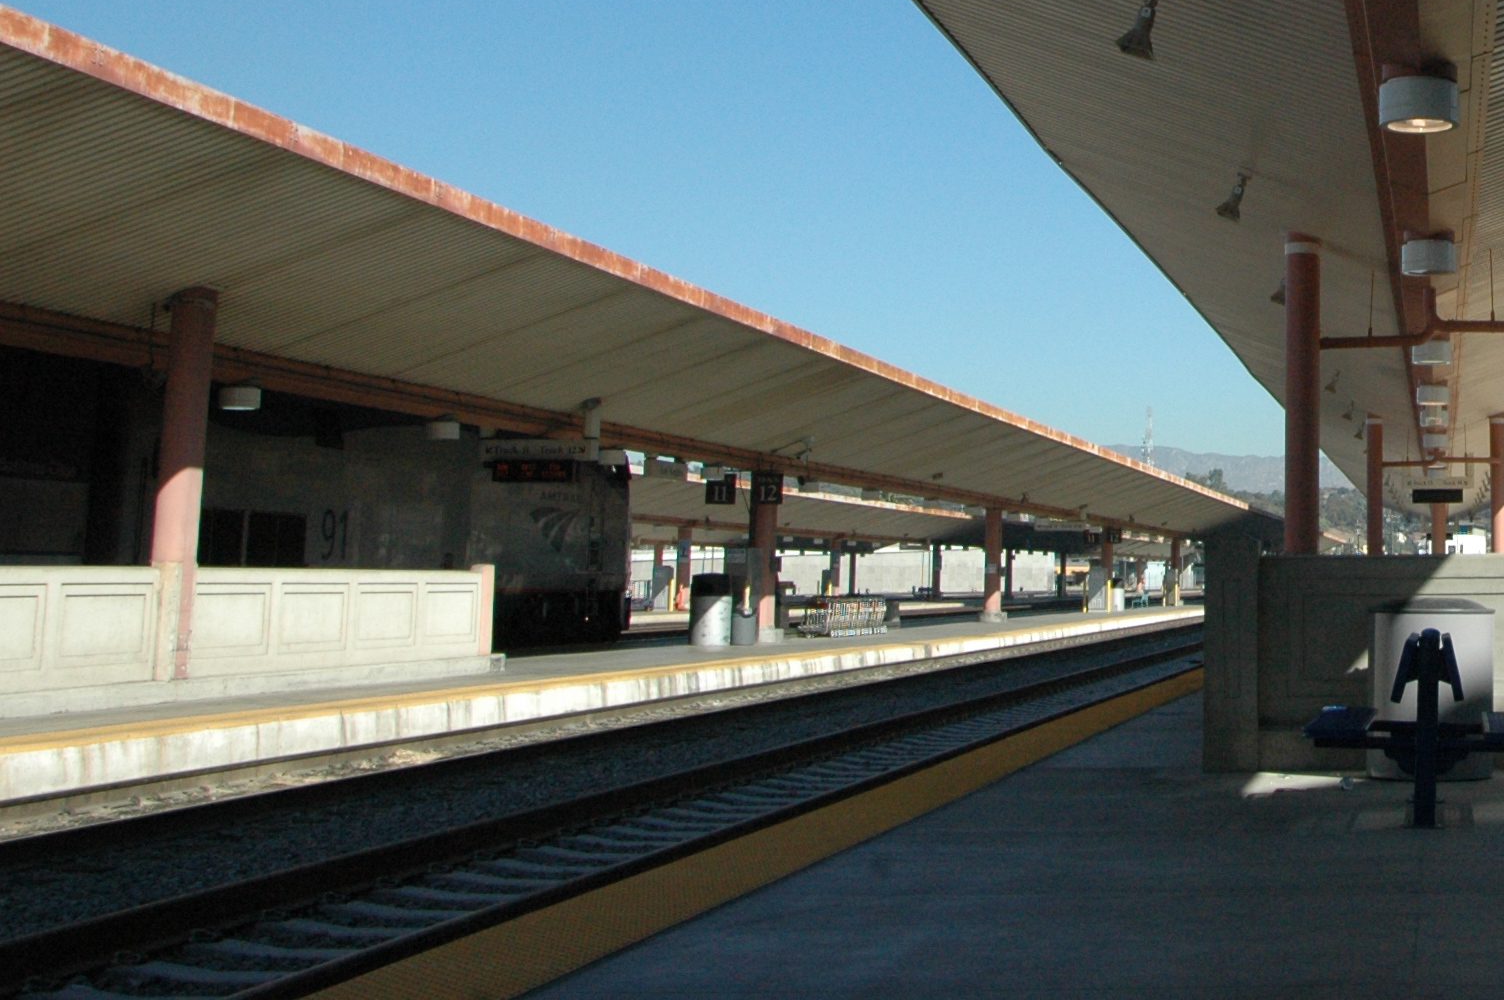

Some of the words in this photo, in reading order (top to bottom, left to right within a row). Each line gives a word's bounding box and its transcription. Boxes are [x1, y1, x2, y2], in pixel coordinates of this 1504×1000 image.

[713, 485, 727, 501] 11
[759, 484, 777, 501] 12
[321, 508, 349, 560] 91
